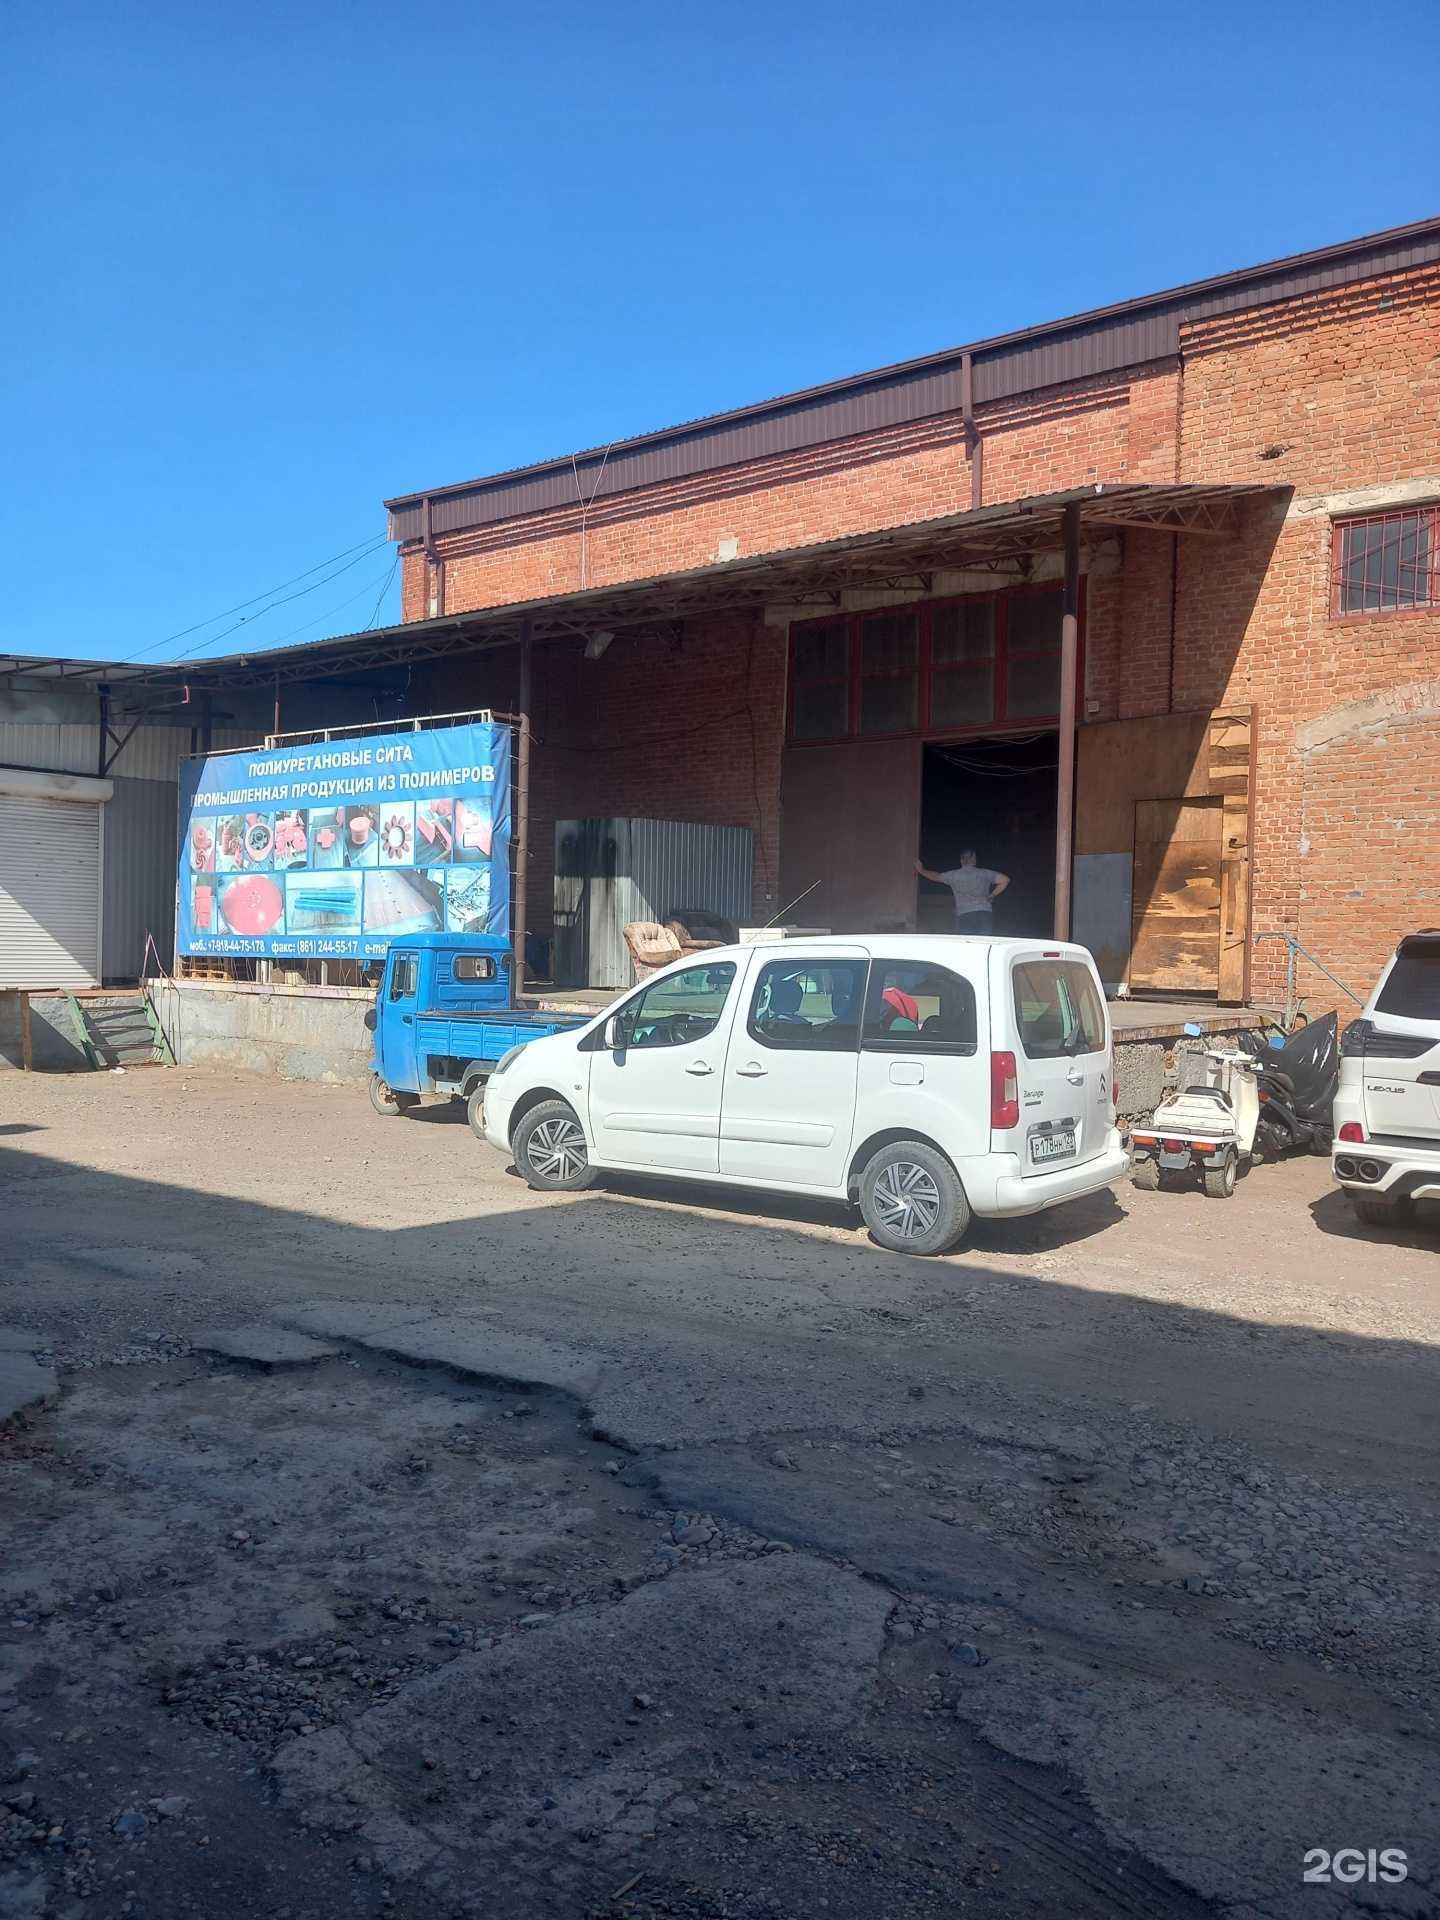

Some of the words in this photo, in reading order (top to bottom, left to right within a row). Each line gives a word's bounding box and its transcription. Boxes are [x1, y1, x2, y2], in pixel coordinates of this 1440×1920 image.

[249, 748, 371, 777] ПОЛИУРЕТАНОВЫЕ
[376, 745, 413, 763] СИТА
[291, 776, 374, 801] ПРОДУКЦИЯ
[378, 775, 395, 790] ИЗ
[401, 765, 495, 790] ПОЛИМЕРОВ
[271, 942, 296, 955] факс:
[297, 941, 316, 955] (861)
[318, 940, 358, 953] 244-55-17
[1367, 1085, 1406, 1093] LEXUS
